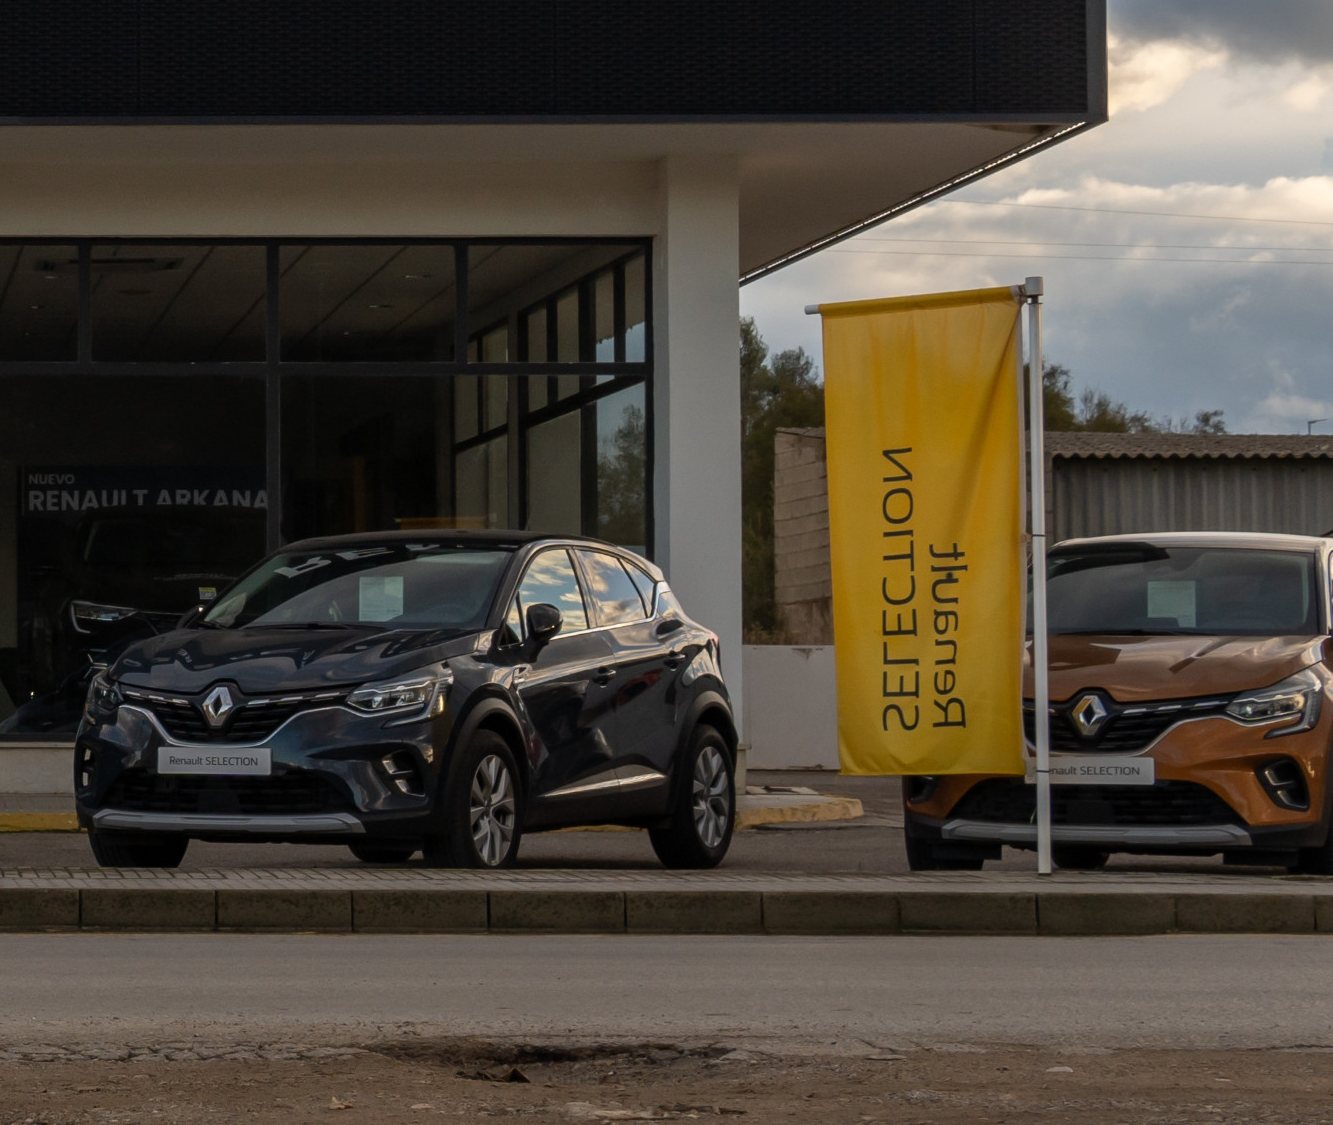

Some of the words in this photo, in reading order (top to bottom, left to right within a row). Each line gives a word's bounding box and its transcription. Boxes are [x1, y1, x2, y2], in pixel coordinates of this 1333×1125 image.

[28, 473, 75, 486] NUEVO
[169, 755, 203, 766] Renault
[205, 757, 259, 767] SELECTION
[1049, 766, 1077, 776] enault
[1079, 766, 1141, 776] SELECTION
